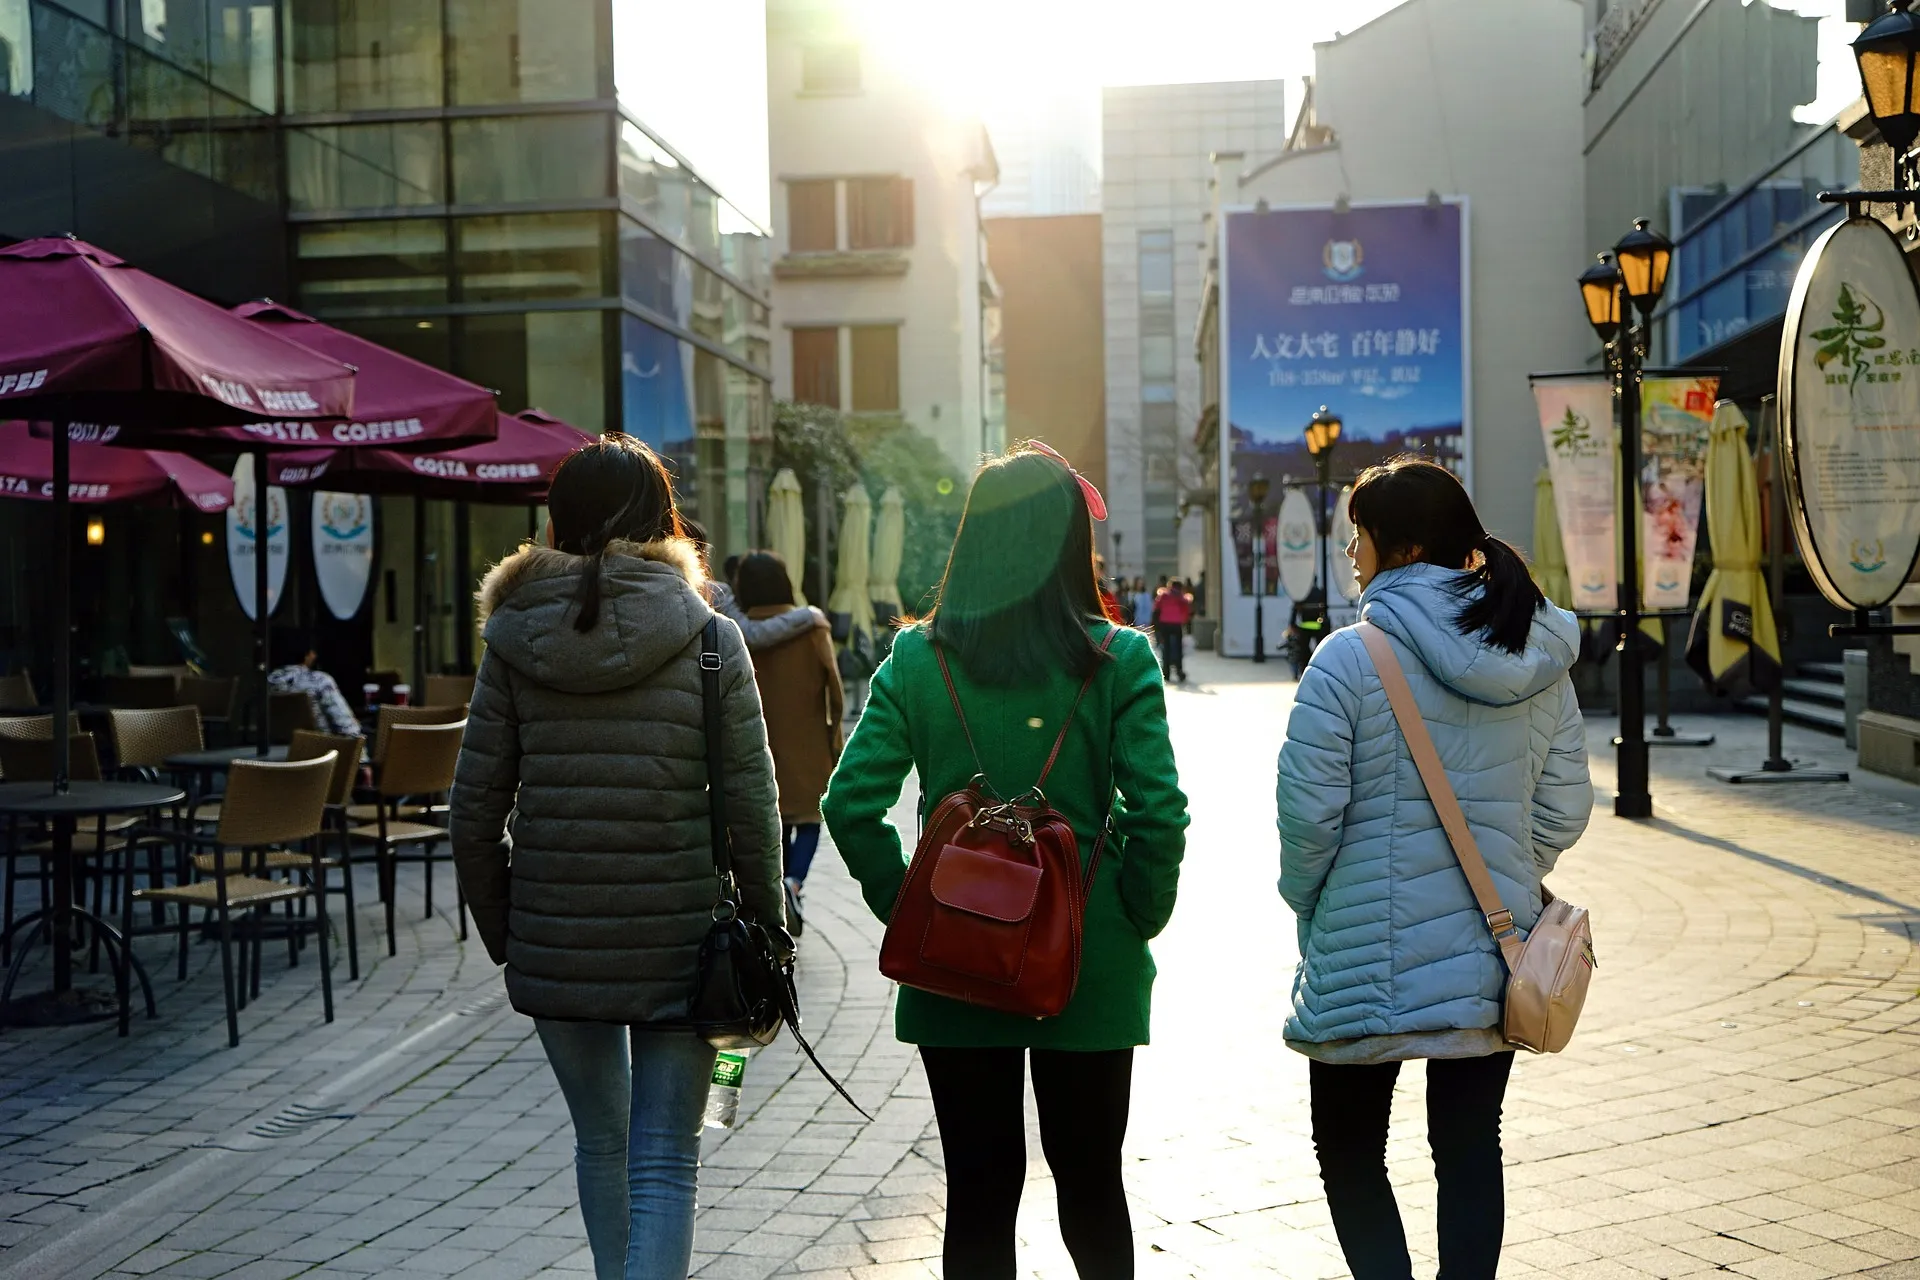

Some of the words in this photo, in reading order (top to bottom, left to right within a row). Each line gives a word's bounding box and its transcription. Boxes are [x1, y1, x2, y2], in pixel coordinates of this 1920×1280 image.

[1251, 333, 1339, 359] 人文大宅
[1351, 329, 1441, 356] 百年静好
[0, 369, 48, 394] FEE
[332, 418, 424, 442] COFFEE
[414, 456, 469, 477] COSTA
[475, 463, 541, 479] COFFEE
[41, 481, 111, 499] CFFEE
